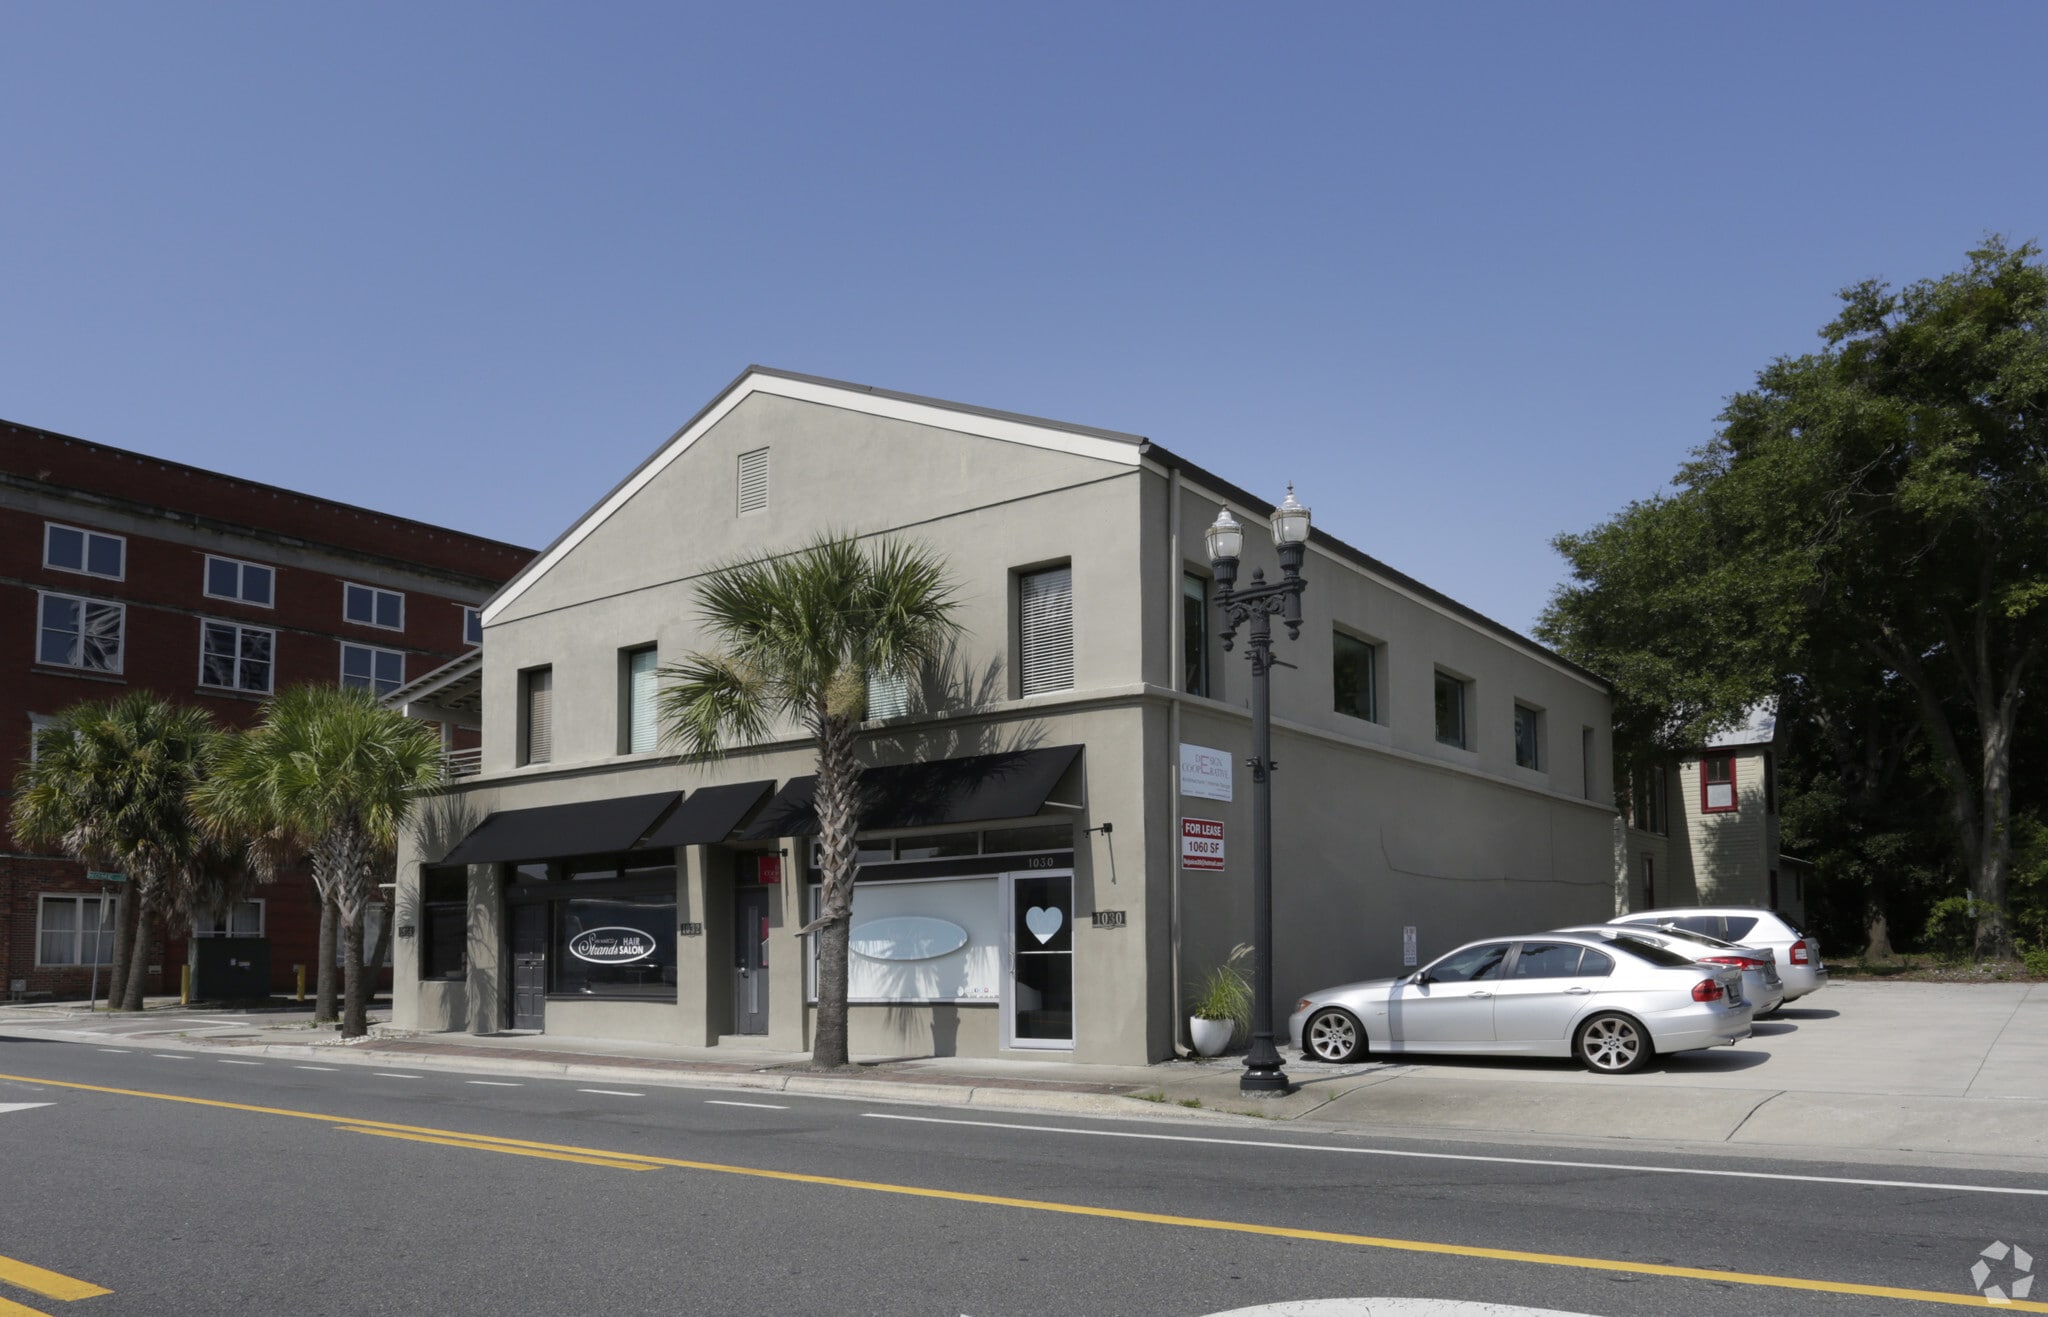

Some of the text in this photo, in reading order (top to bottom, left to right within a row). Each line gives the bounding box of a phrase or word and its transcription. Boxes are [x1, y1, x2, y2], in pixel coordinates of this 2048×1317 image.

[1185, 822, 1222, 836] FOR LEASE
[1188, 841, 1220, 854] 1060 SF
[1028, 857, 1054, 868] 1030
[1095, 912, 1123, 925] 1030
[578, 932, 618, 956] Strands
[623, 937, 640, 946] HAIR
[619, 945, 644, 955] SALON
